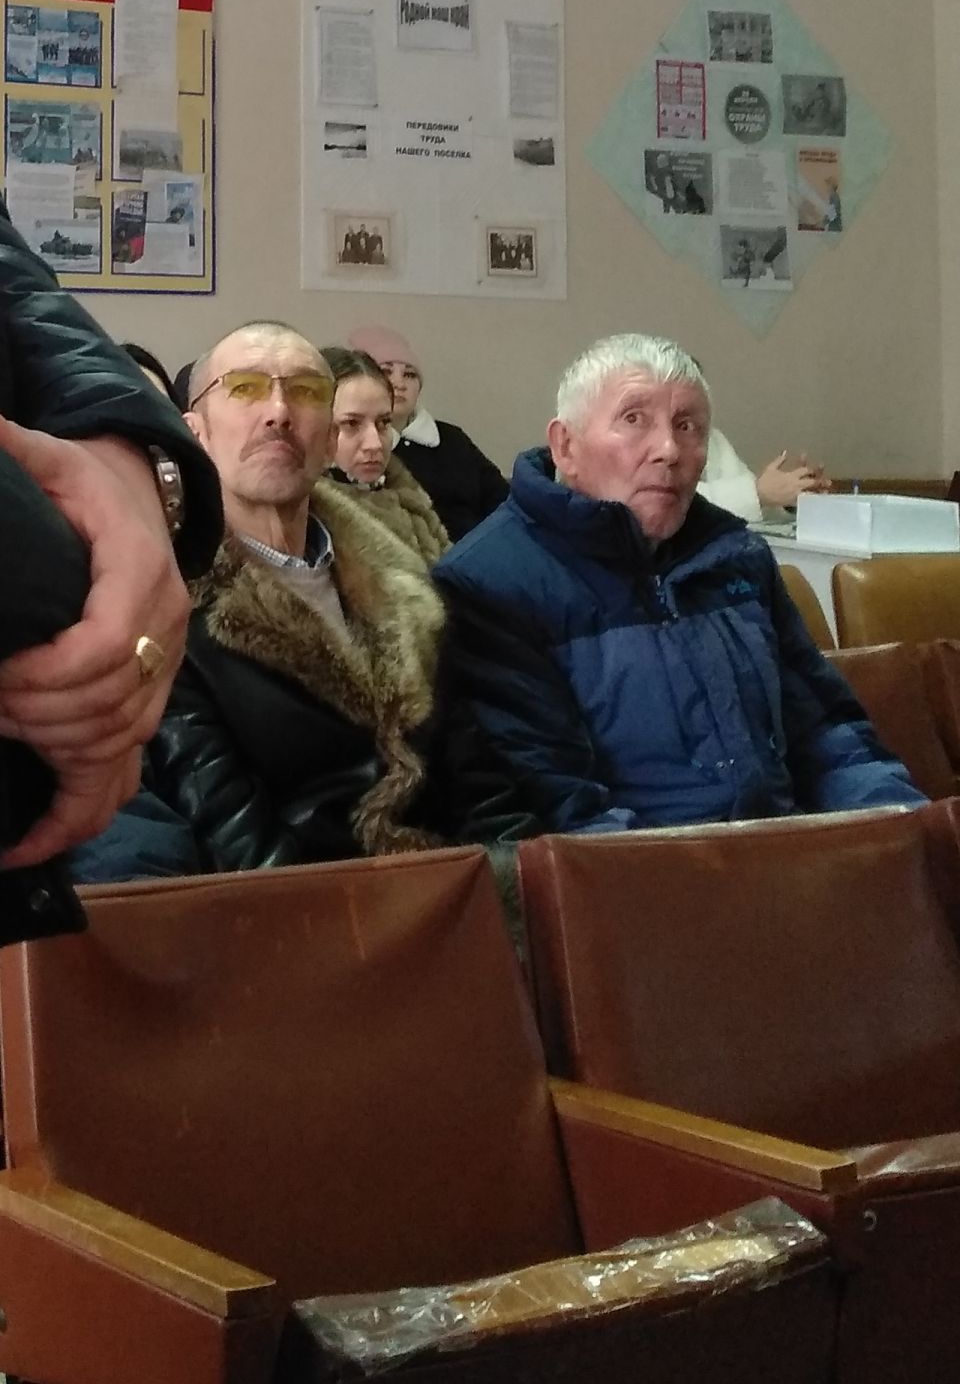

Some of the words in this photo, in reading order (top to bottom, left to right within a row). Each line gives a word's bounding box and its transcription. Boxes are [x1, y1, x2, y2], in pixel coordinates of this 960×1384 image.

[406, 121, 459, 132] ПЕРЕДОВИКИ
[420, 134, 446, 145] ТРУДА
[395, 147, 431, 157] НАШЕГО
[434, 149, 471, 159] ПОСЕЛКА
